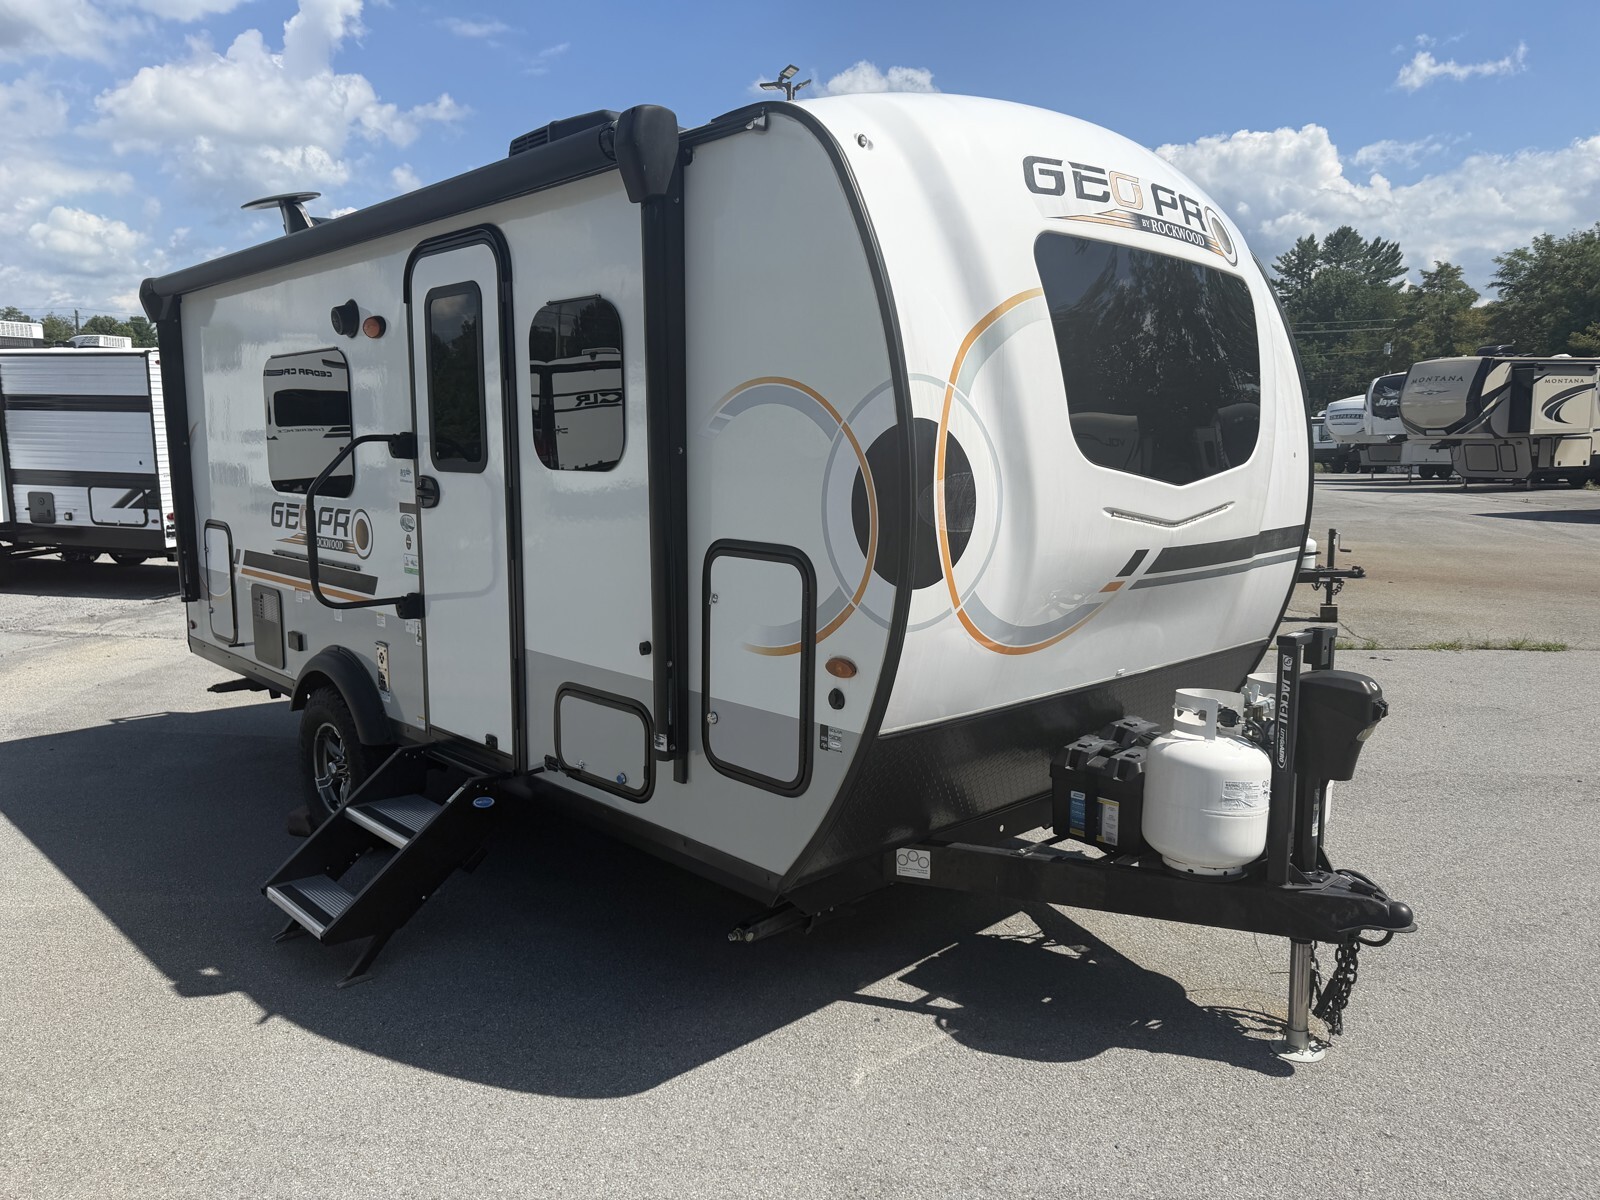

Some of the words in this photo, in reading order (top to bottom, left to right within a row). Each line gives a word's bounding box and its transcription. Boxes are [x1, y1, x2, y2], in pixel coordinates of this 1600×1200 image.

[1022, 155, 1144, 210] GEO
[1150, 183, 1238, 267] PRO
[1142, 218, 1150, 228] BY
[1151, 219, 1205, 247] ROCKWOOD
[1411, 375, 1464, 385] MONTANA
[1376, 397, 1399, 408] Jayc
[317, 507, 373, 560] PRO
